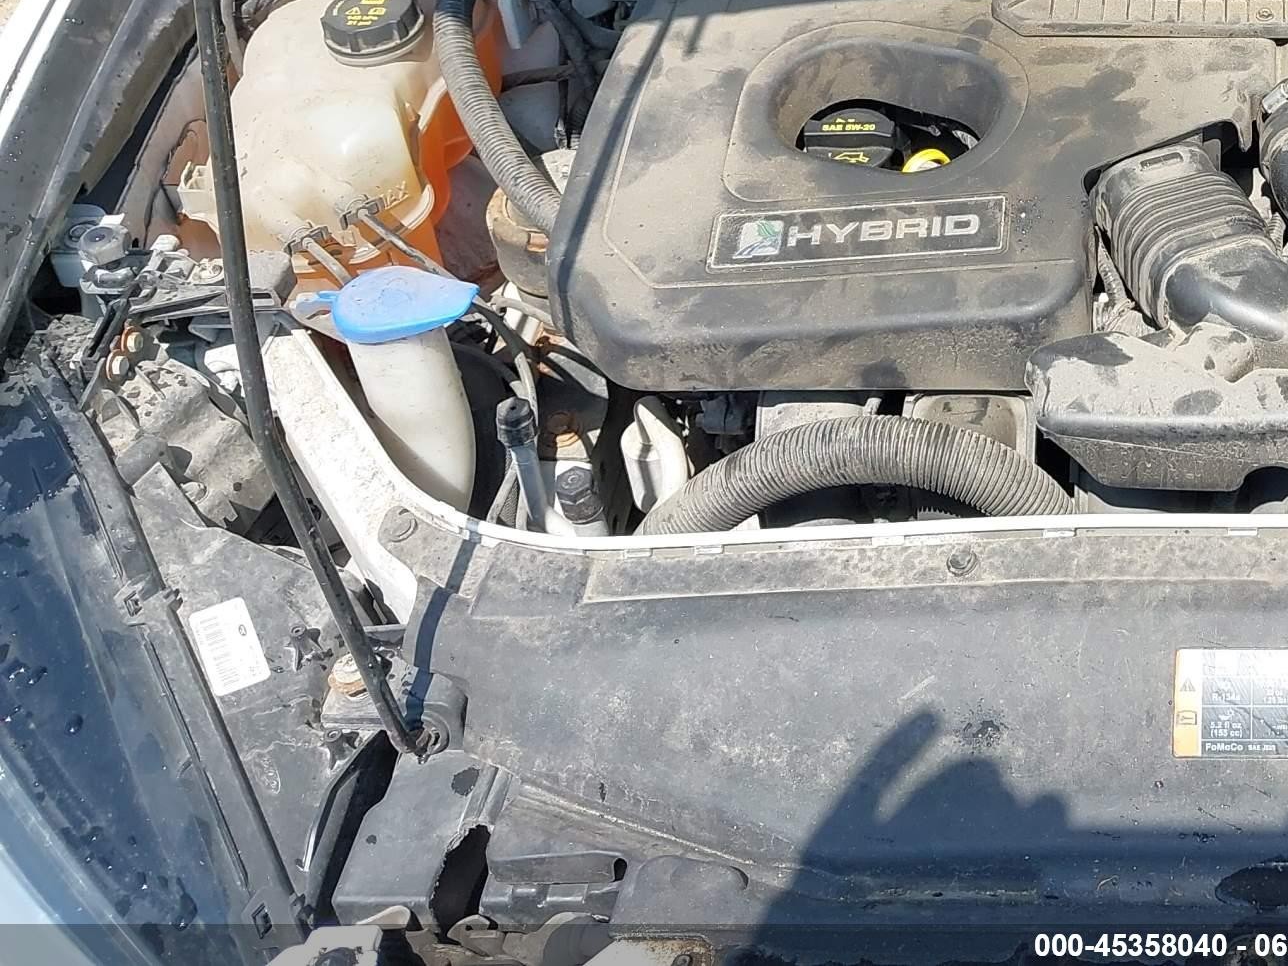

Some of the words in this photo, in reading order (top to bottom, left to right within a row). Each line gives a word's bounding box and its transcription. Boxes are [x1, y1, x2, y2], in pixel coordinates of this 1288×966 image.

[845, 123, 876, 131] 5W-20
[786, 213, 981, 248] HYBRID
[1205, 742, 1244, 752] FoMoCo
